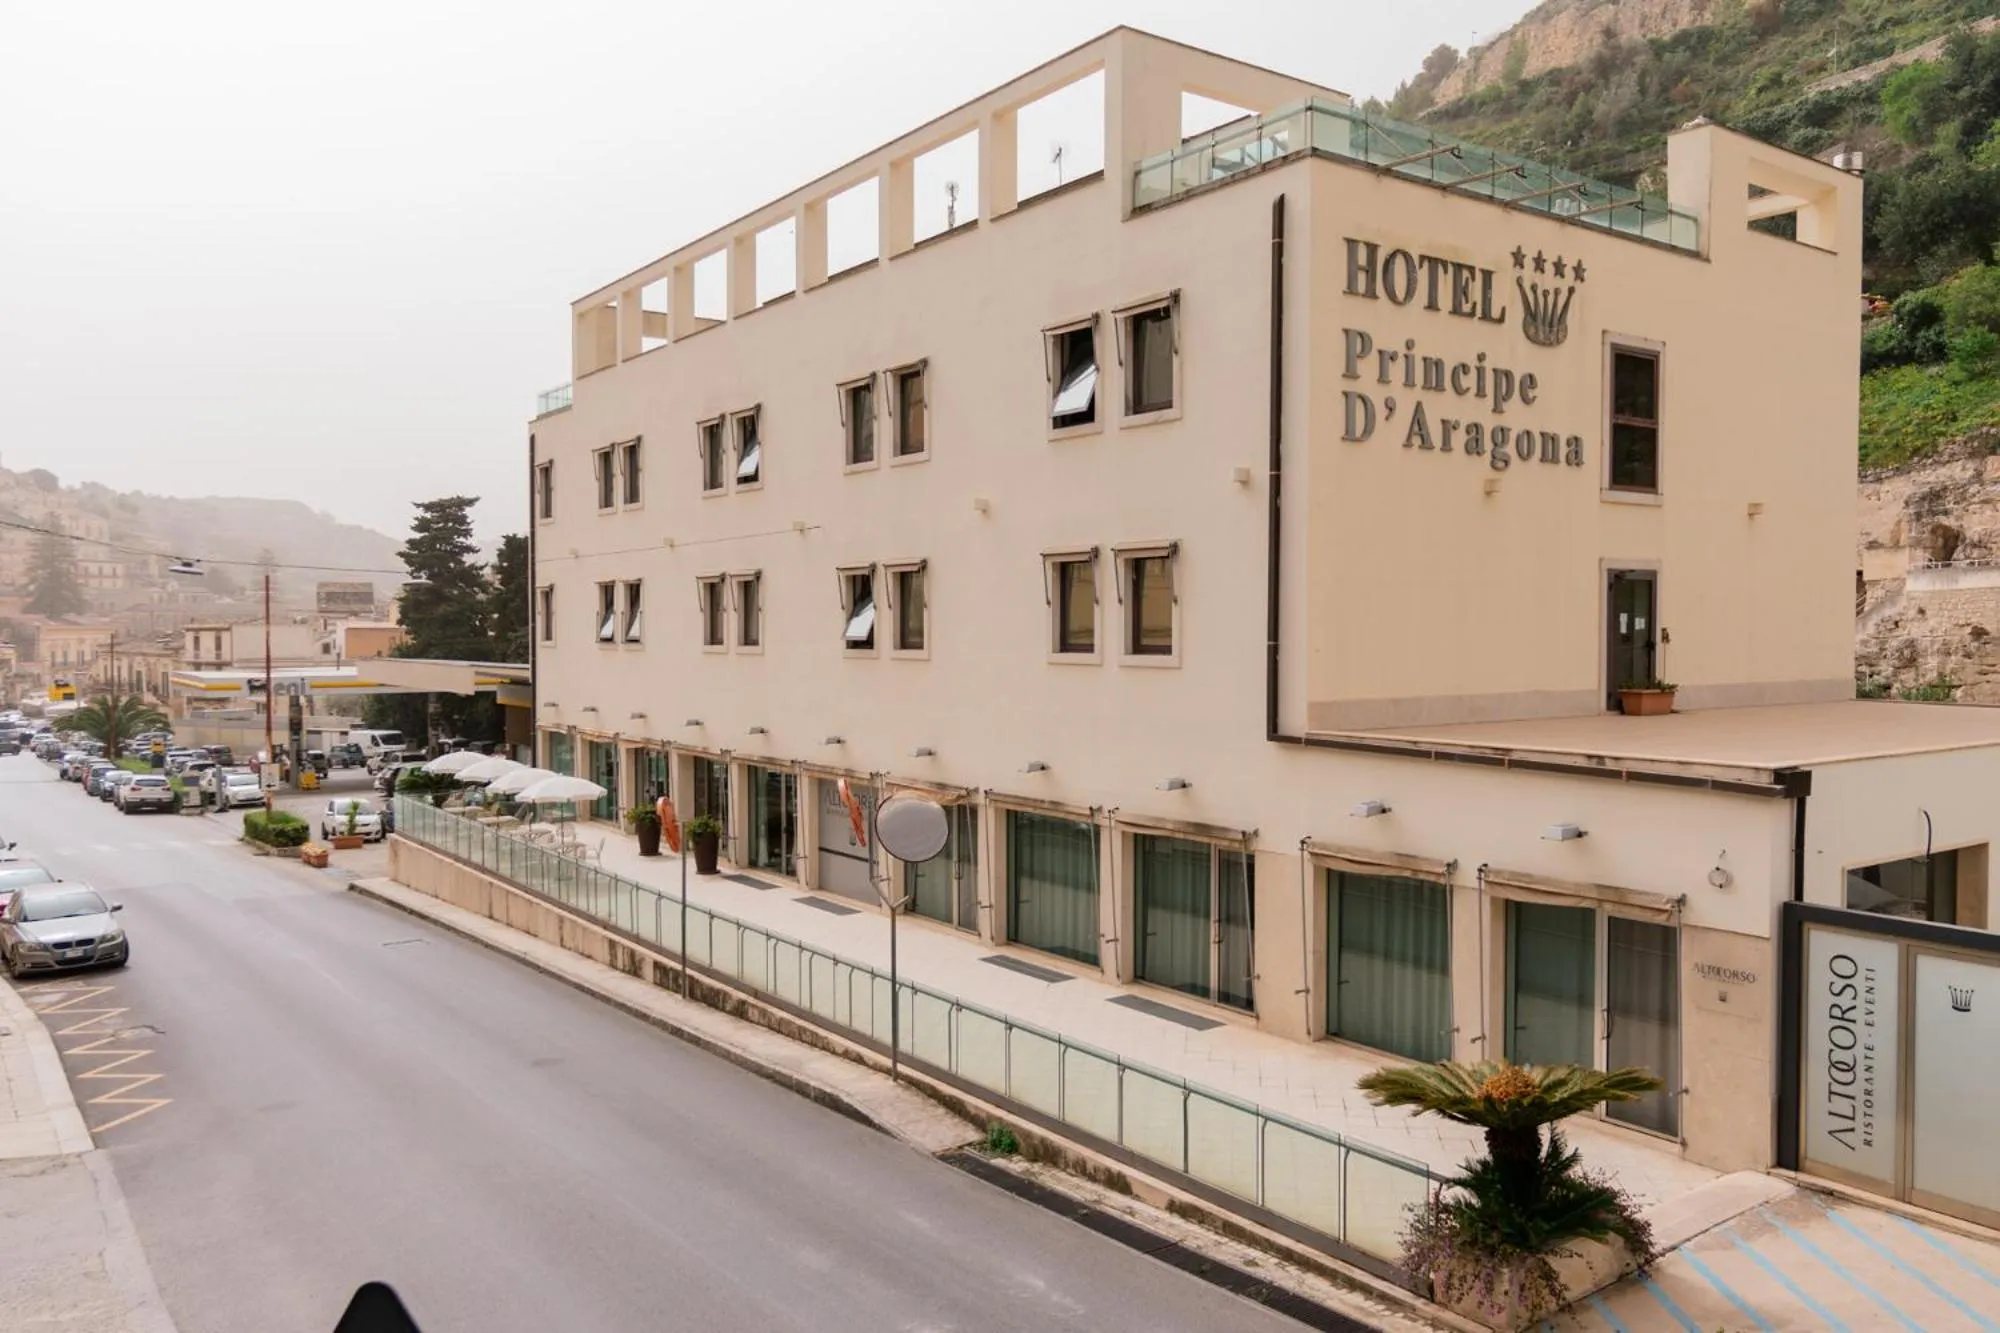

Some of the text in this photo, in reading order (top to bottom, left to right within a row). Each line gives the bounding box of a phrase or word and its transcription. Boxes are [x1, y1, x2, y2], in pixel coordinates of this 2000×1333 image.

[1342, 237, 1506, 324] HOTEL
[1342, 328, 1538, 414] Principe
[1864, 967, 1876, 1027] EVENTI
[1828, 954, 1858, 1151] ALTOCORSO
[1863, 1042, 1875, 1147] RISTORANTE
